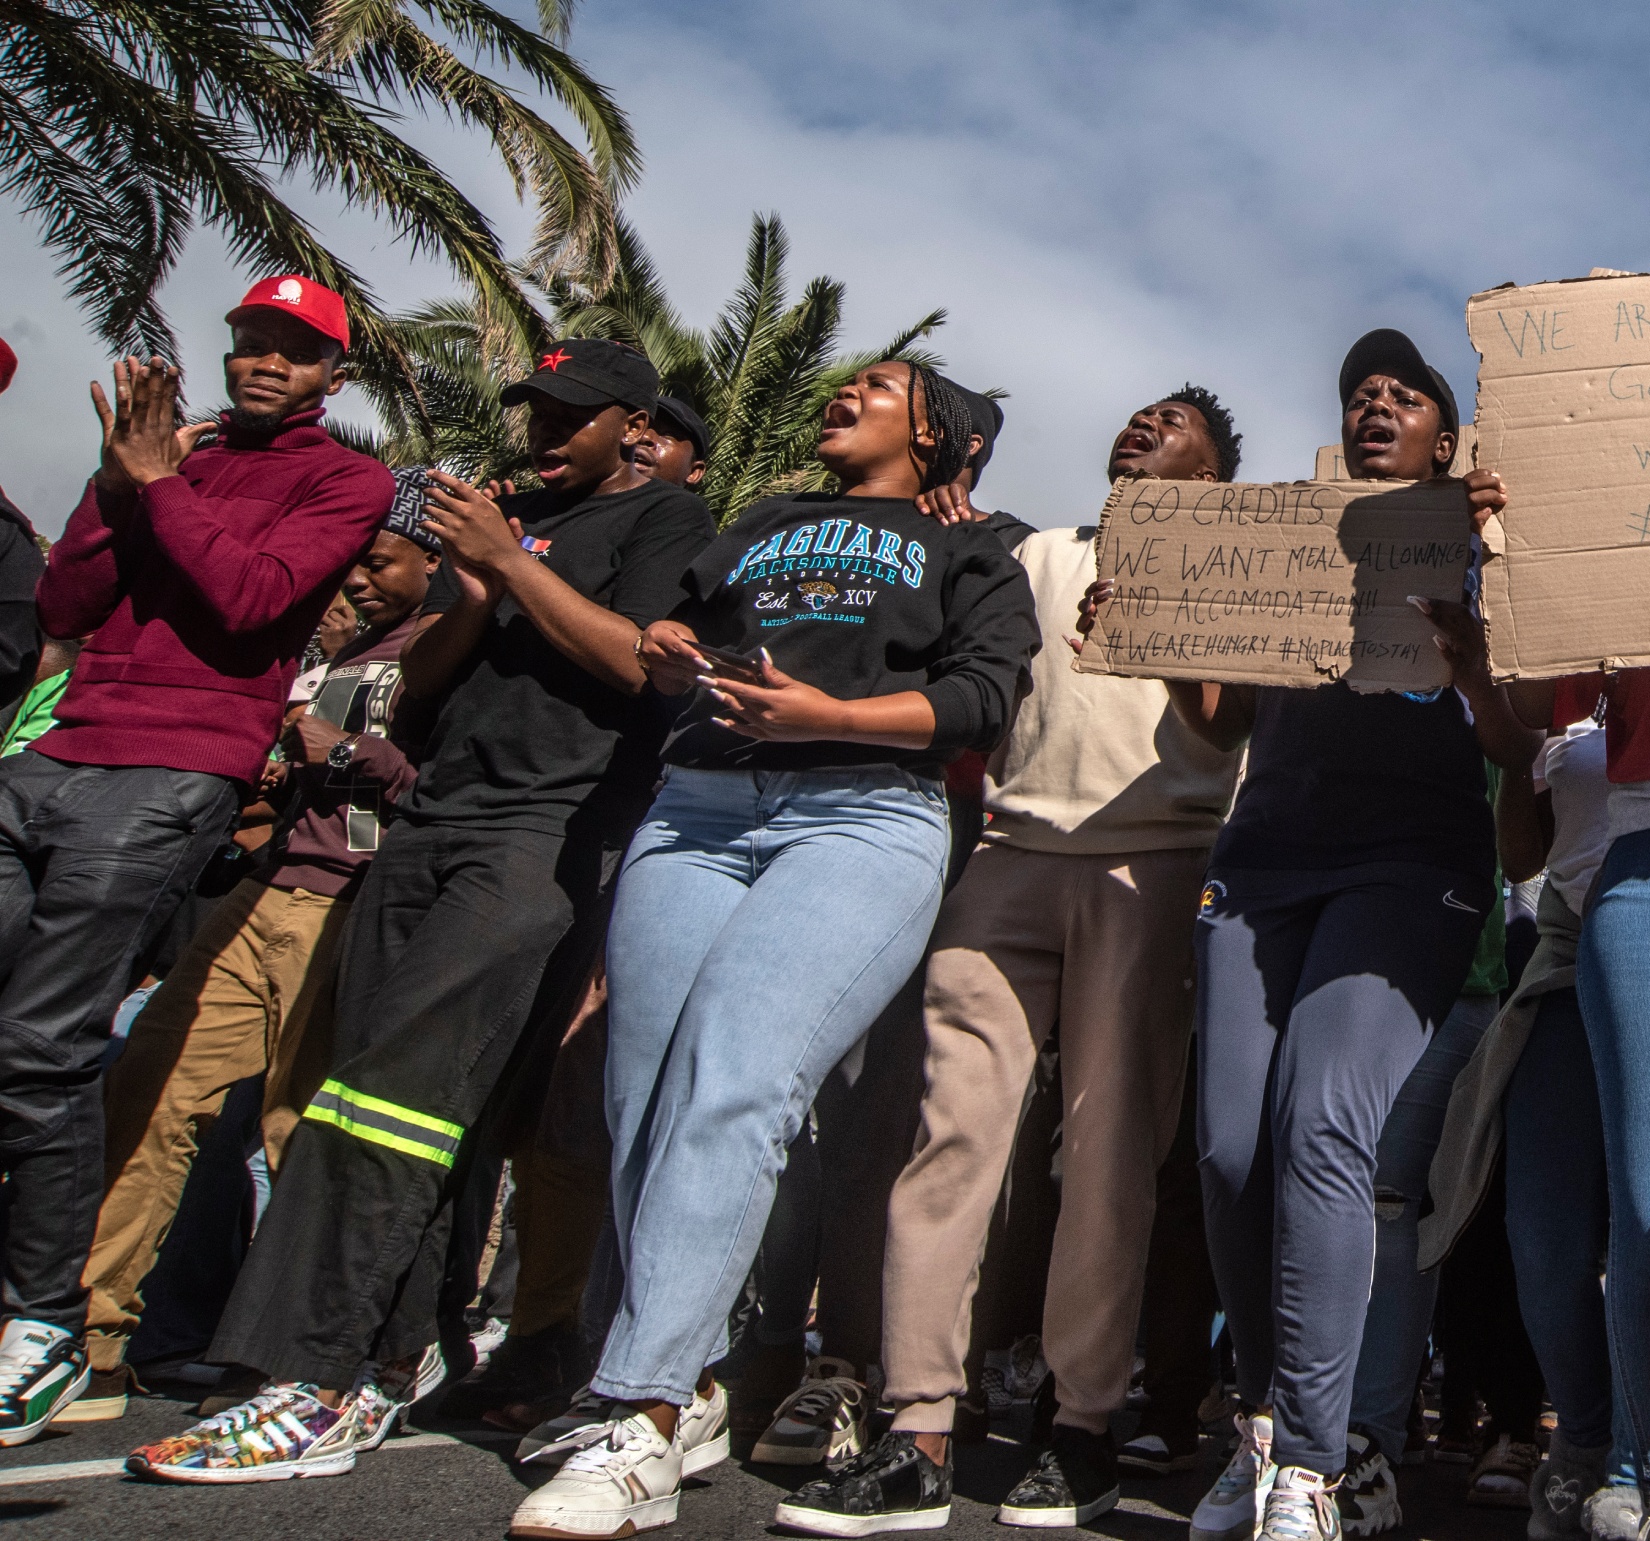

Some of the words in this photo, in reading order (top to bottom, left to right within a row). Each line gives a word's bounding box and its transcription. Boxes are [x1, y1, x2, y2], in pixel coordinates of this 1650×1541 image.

[1497, 310, 1575, 358] WE
[1130, 485, 1181, 525] 60
[1192, 486, 1332, 526] CREDITS
[726, 519, 926, 589] JAGUARS
[1115, 537, 1166, 578] WE
[1181, 544, 1279, 581] WANT
[1286, 543, 1345, 578] MEAL
[1354, 542, 1468, 572] ALLOWANCE
[743, 556, 898, 585] JACKSONVILLE
[842, 589, 877, 606] XCV
[1105, 584, 1160, 619] AND
[834, 613, 865, 624] LEAGUE
[23, 1333, 50, 1346] PUMA
[1297, 1471, 1318, 1483] PUMA
